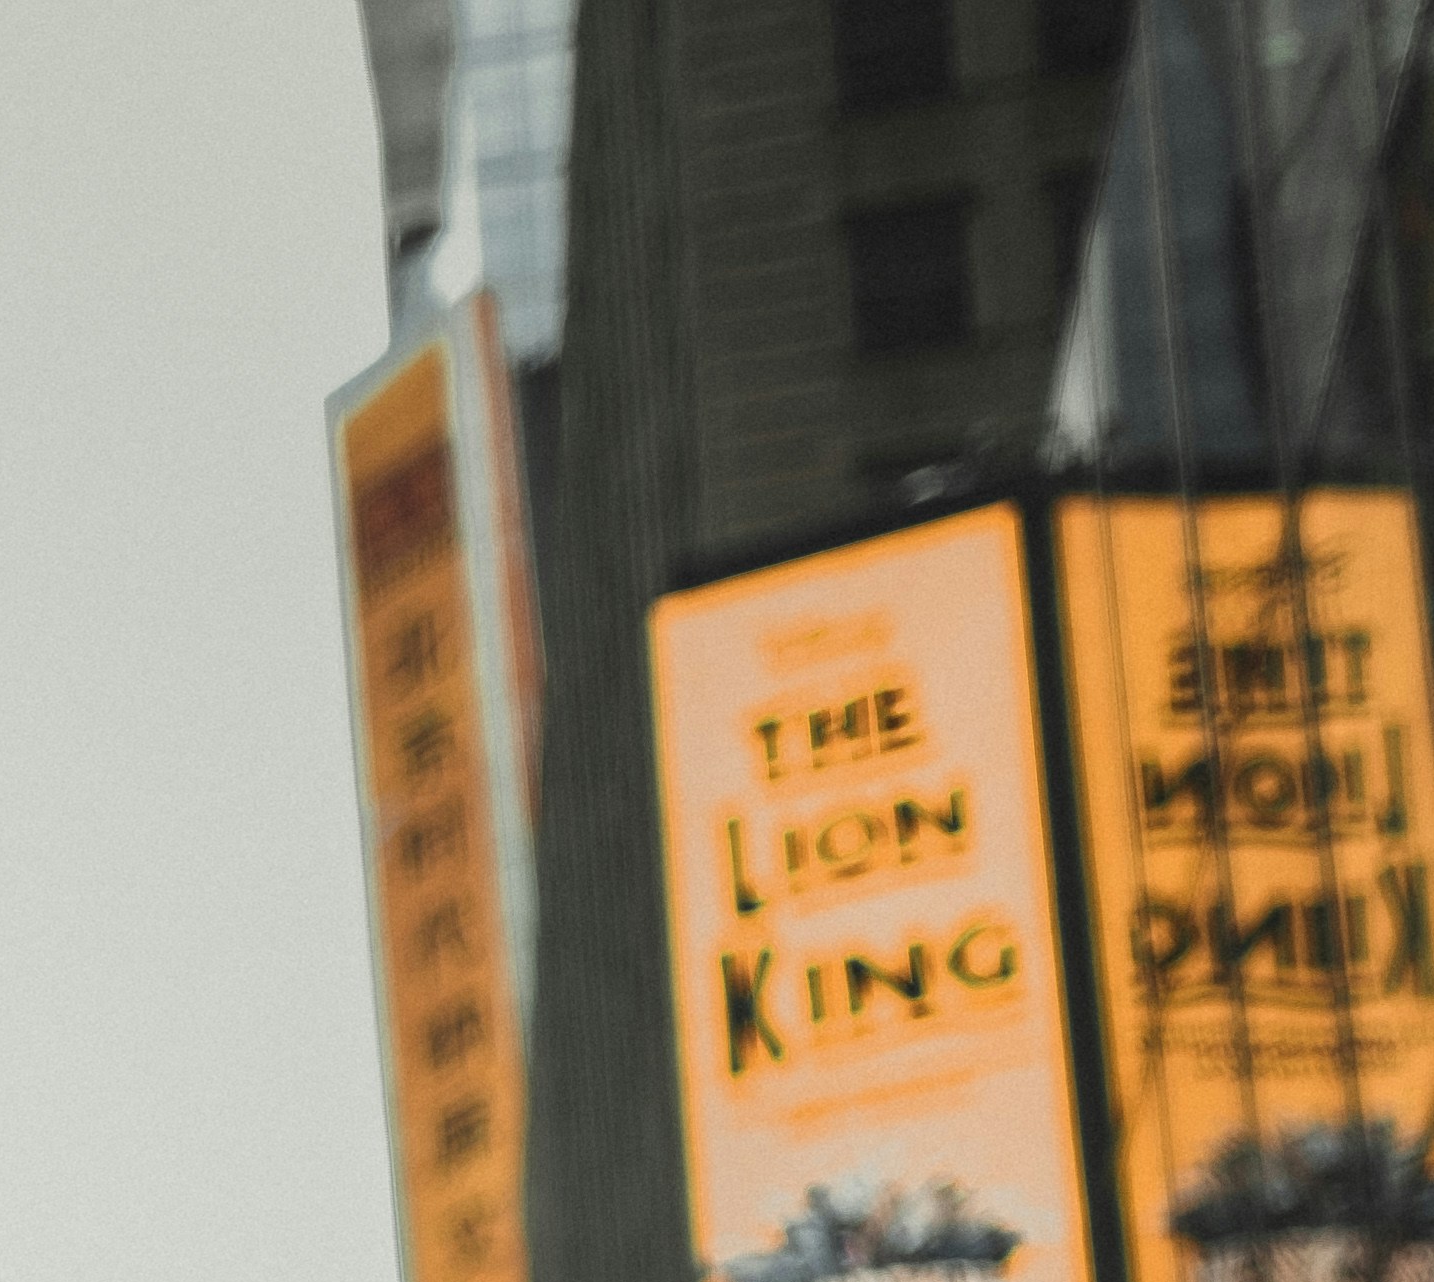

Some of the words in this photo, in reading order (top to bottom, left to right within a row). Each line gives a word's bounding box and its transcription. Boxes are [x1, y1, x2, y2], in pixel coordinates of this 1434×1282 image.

[756, 686, 922, 782] THE
[728, 788, 972, 915] LION
[720, 920, 1020, 1078] KING
